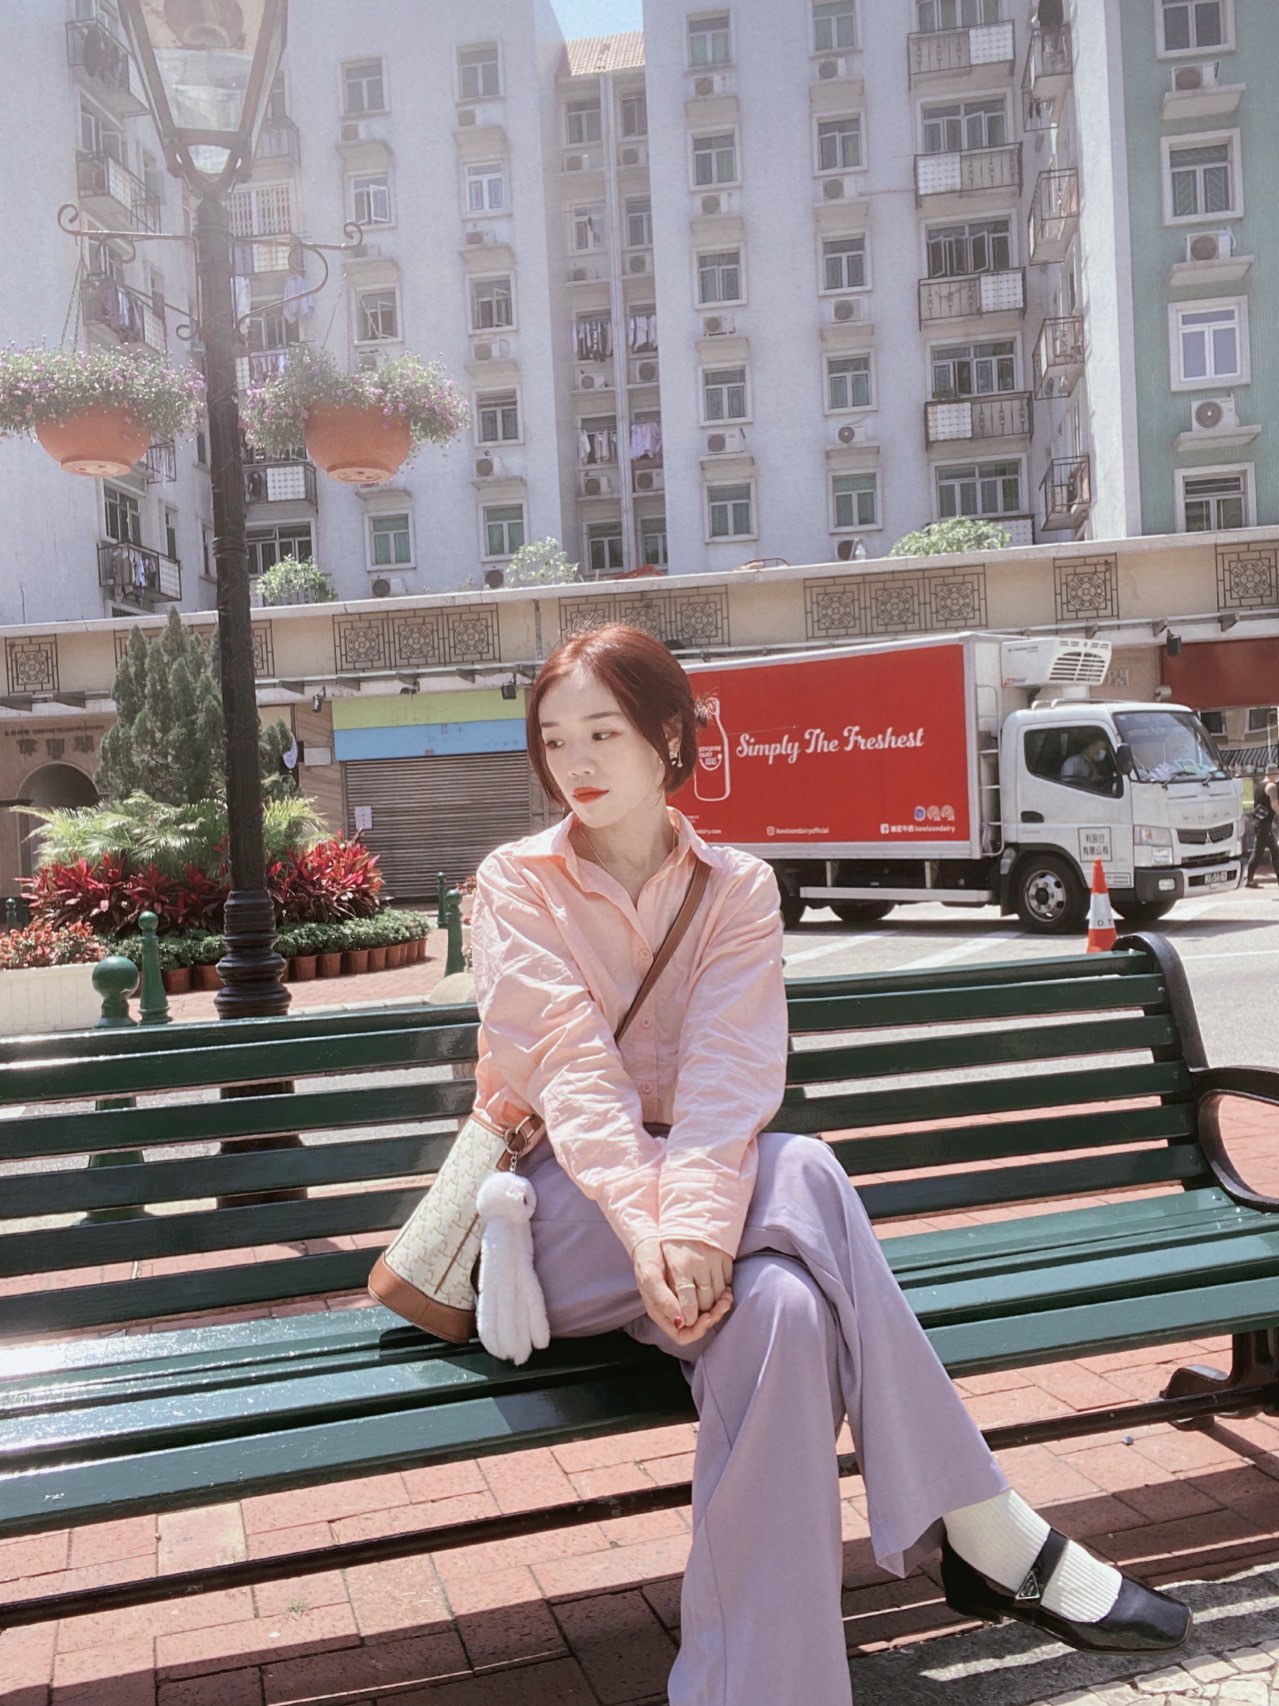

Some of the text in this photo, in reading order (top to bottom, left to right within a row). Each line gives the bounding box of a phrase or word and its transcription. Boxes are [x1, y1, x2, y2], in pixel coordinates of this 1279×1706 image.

[736, 725, 924, 765] Simply The Freshest
